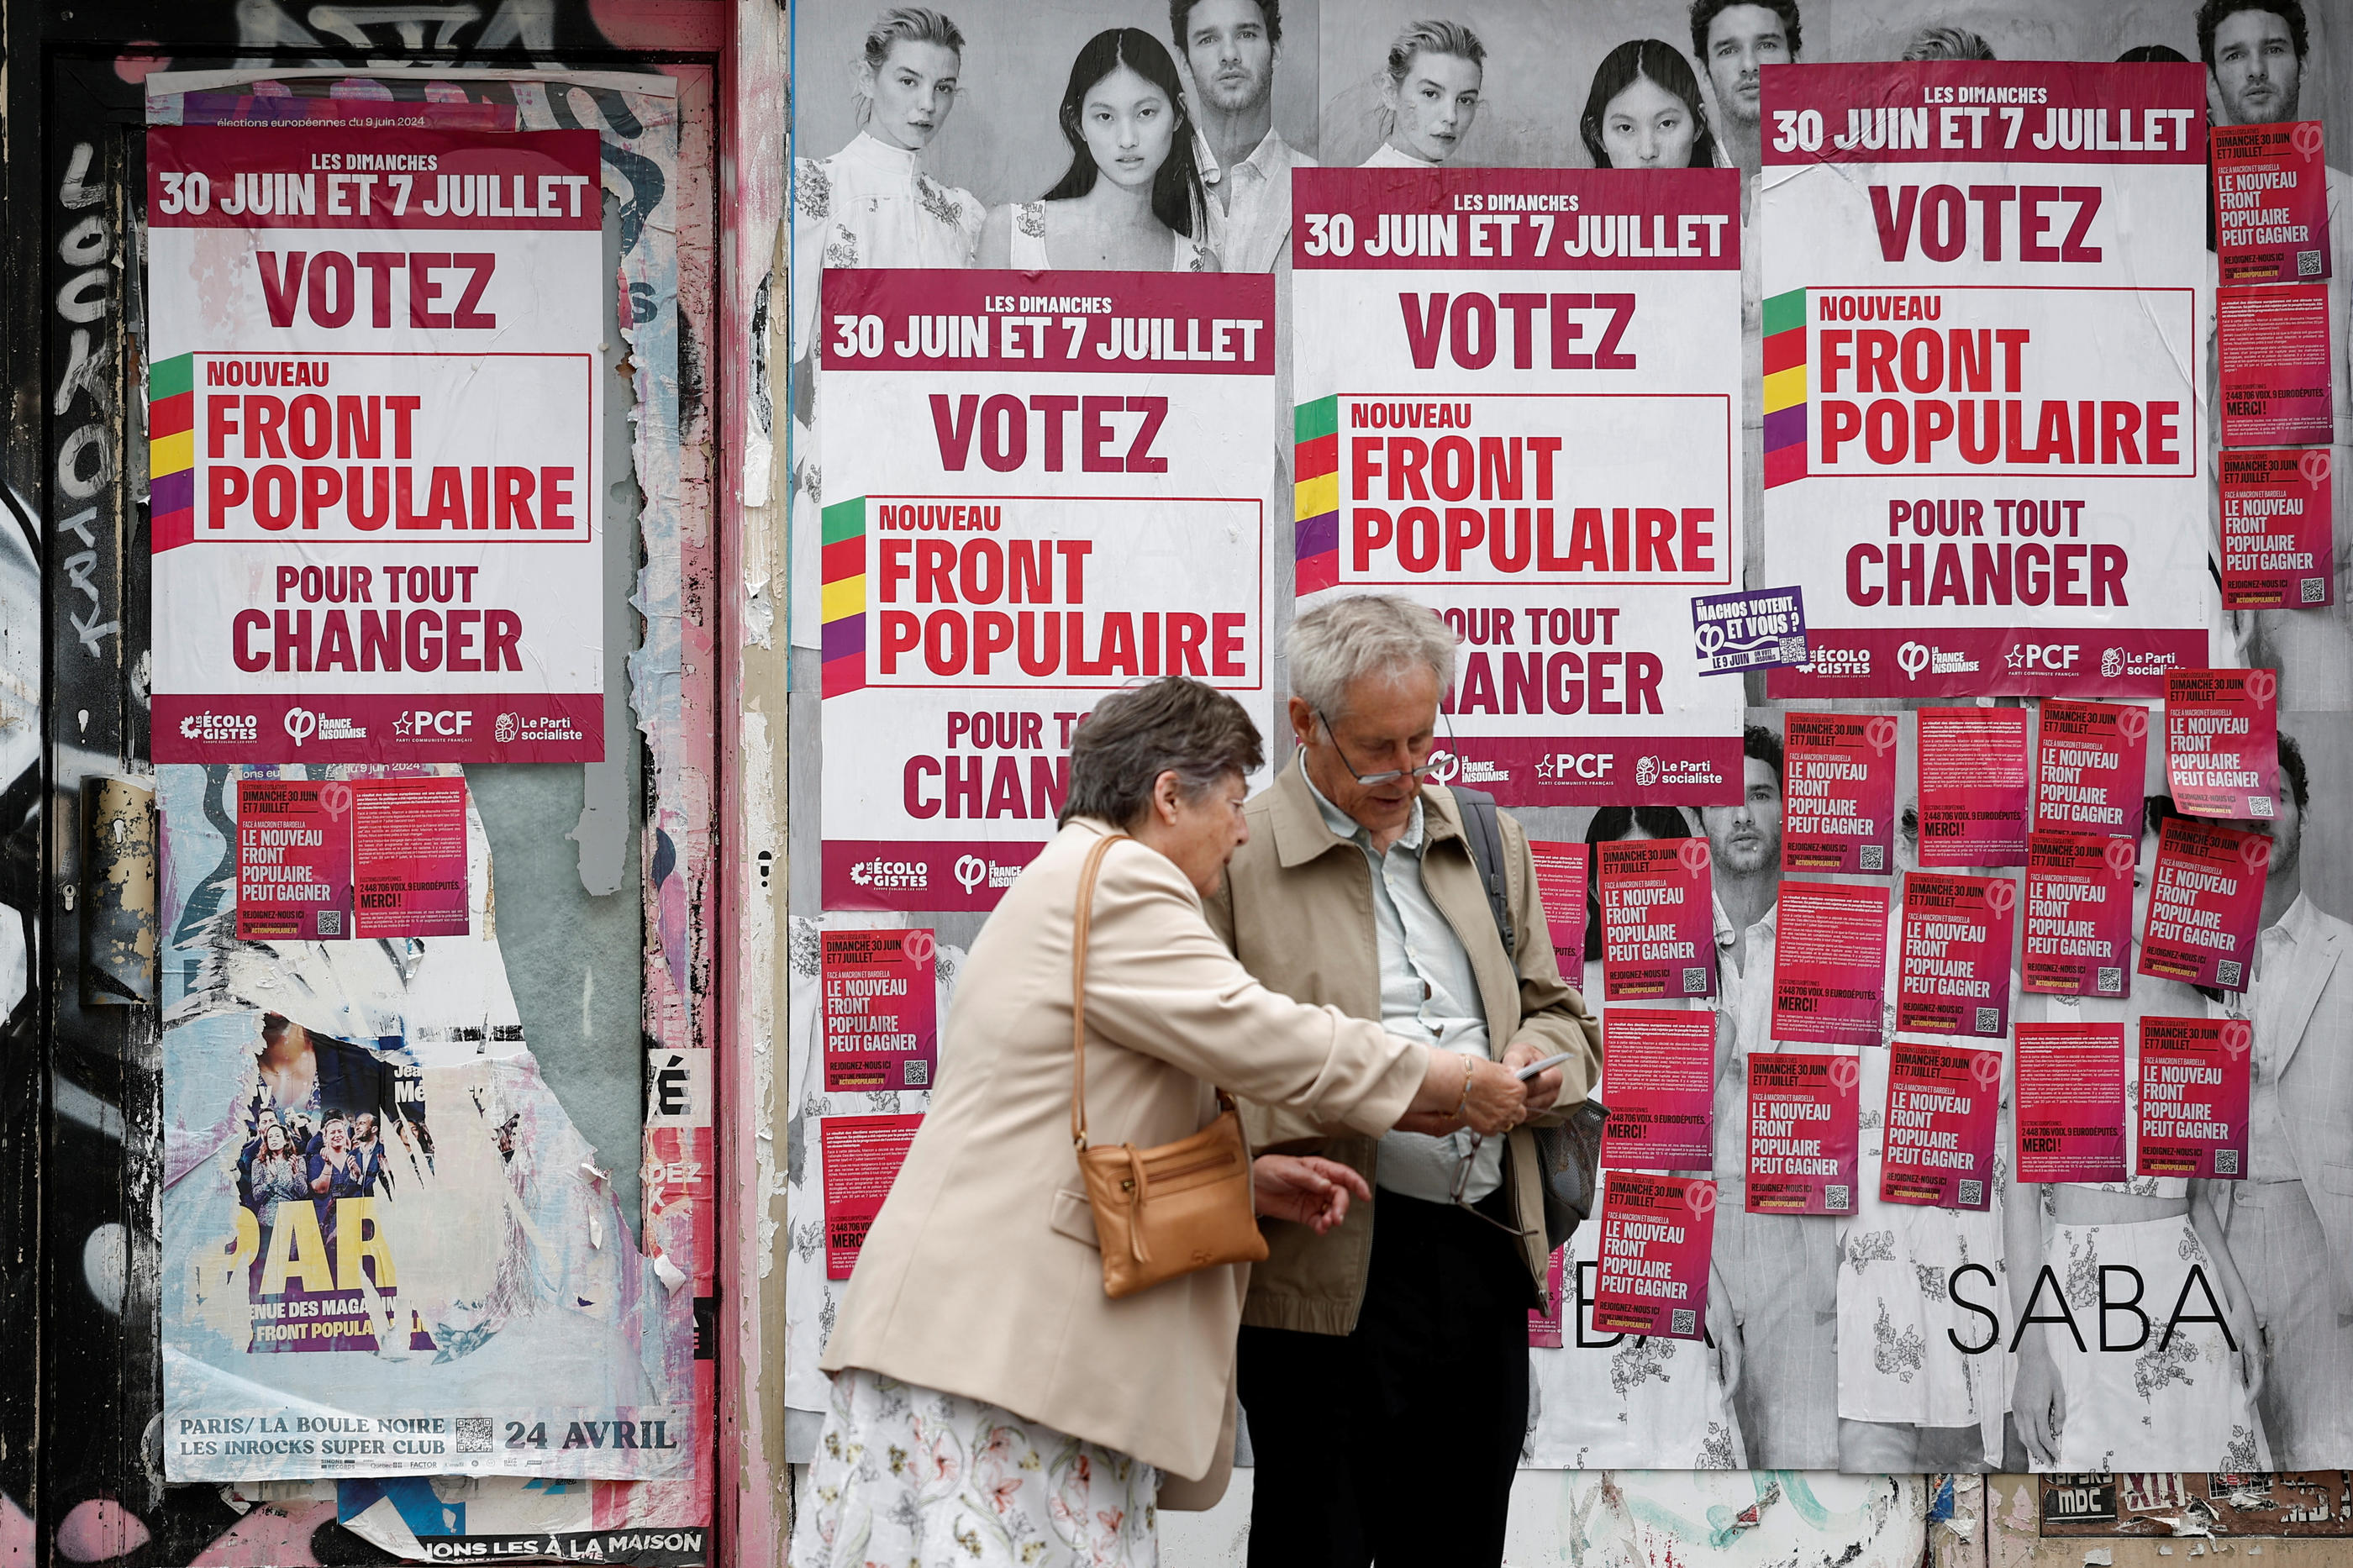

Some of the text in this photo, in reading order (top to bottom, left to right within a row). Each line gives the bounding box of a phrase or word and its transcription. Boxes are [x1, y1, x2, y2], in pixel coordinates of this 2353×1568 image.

[1924, 87, 2047, 103] LES DIMANCHES
[218, 117, 424, 128] élections européennes du 9 juin 2024
[1773, 107, 2194, 152] 30 JUIN ET 7 JUILLET
[312, 154, 437, 171] LES DIMANCHES
[2219, 171, 2298, 192] LE NOUVEAU
[160, 172, 589, 217] 30 JUIN ET 7 JUILLET
[1455, 194, 1579, 211] LES DIMANCHES
[2219, 191, 2262, 210] FRONT
[1869, 185, 2102, 262] VOTEZ
[2221, 208, 2290, 229] POPULAIRE
[1304, 213, 1729, 257] 30 JUIN ET 7 JUILLET
[2222, 225, 2308, 247] PEUT GAGNER
[256, 251, 495, 329] VOTEZ
[986, 296, 1112, 313] LES DIMANCHES
[1820, 296, 1940, 321] NOUVEAU
[834, 314, 1263, 361] 30 JUIN ET 7 JUILLET
[1400, 292, 1635, 369] VOTEZ
[1821, 328, 2029, 393] FRONT
[208, 361, 329, 387] NOUVEAU
[208, 394, 420, 460] FRONT
[1352, 403, 1471, 428] NOUVEAU
[929, 394, 1167, 472] VOTEZ
[1822, 399, 2179, 465] POPULAIRE
[1352, 436, 1561, 502] FRONT
[208, 465, 574, 530] POPULAIRE
[881, 505, 1000, 531] NOUVEAU
[1890, 500, 2084, 537] POUR TOUT
[1353, 507, 1714, 572] POPULAIRE
[881, 539, 1092, 604] FRONT
[1847, 543, 2128, 606] CHANGER
[277, 566, 478, 602] POUR TOUT
[1697, 597, 1798, 622] MACHOS VOTENT.
[1526, 608, 1619, 645] TOUT
[1726, 619, 1744, 639] ET
[1745, 614, 1788, 637] VOUS
[234, 609, 522, 672] CHANGER
[881, 609, 1245, 676] POPULAIRE
[1713, 654, 1749, 668] LE 9 JUIN
[1440, 651, 1664, 715] ANGER
[203, 709, 257, 727] ÉCOLO
[319, 718, 352, 729] FRANCE
[415, 711, 472, 735] PCF
[522, 717, 571, 728] Le Parti
[203, 728, 257, 739] GISTES
[522, 729, 583, 741] socialiste
[948, 712, 1042, 749] POUR
[243, 792, 318, 801] DIMANCHE 30 JUIN
[903, 755, 1071, 819] CHAN
[243, 803, 289, 813] ET 7 JUILLET
[243, 829, 322, 846] LE NOUVEAU
[242, 848, 285, 864] FRONT
[243, 866, 313, 882] POPULAIRE
[243, 885, 330, 902] PEUT GAGNER
[243, 911, 295, 919] REJOIGNEZ-NOUS
[2144, 1066, 2221, 1084] LE NOUVEAU
[2144, 1084, 2185, 1101] FRONT
[2143, 1102, 2211, 1120] POPULAIRE
[2143, 1120, 2228, 1139] PEUT GAGNER
[289, 1301, 319, 1318] DES
[1947, 1263, 2238, 1355] SABA
[257, 1324, 308, 1342] FRONT
[260, 1418, 289, 1433] LA
[296, 1418, 370, 1434] BOULE
[377, 1418, 445, 1434] NOIRE
[505, 1421, 676, 1450] 24 AVRIL
[181, 1439, 445, 1455] LES INROCKS SUPER CLUB
[493, 1540, 539, 1555] LES
[545, 1535, 563, 1555] À
[571, 1538, 603, 1555] LA
[608, 1534, 702, 1553] MAISON
